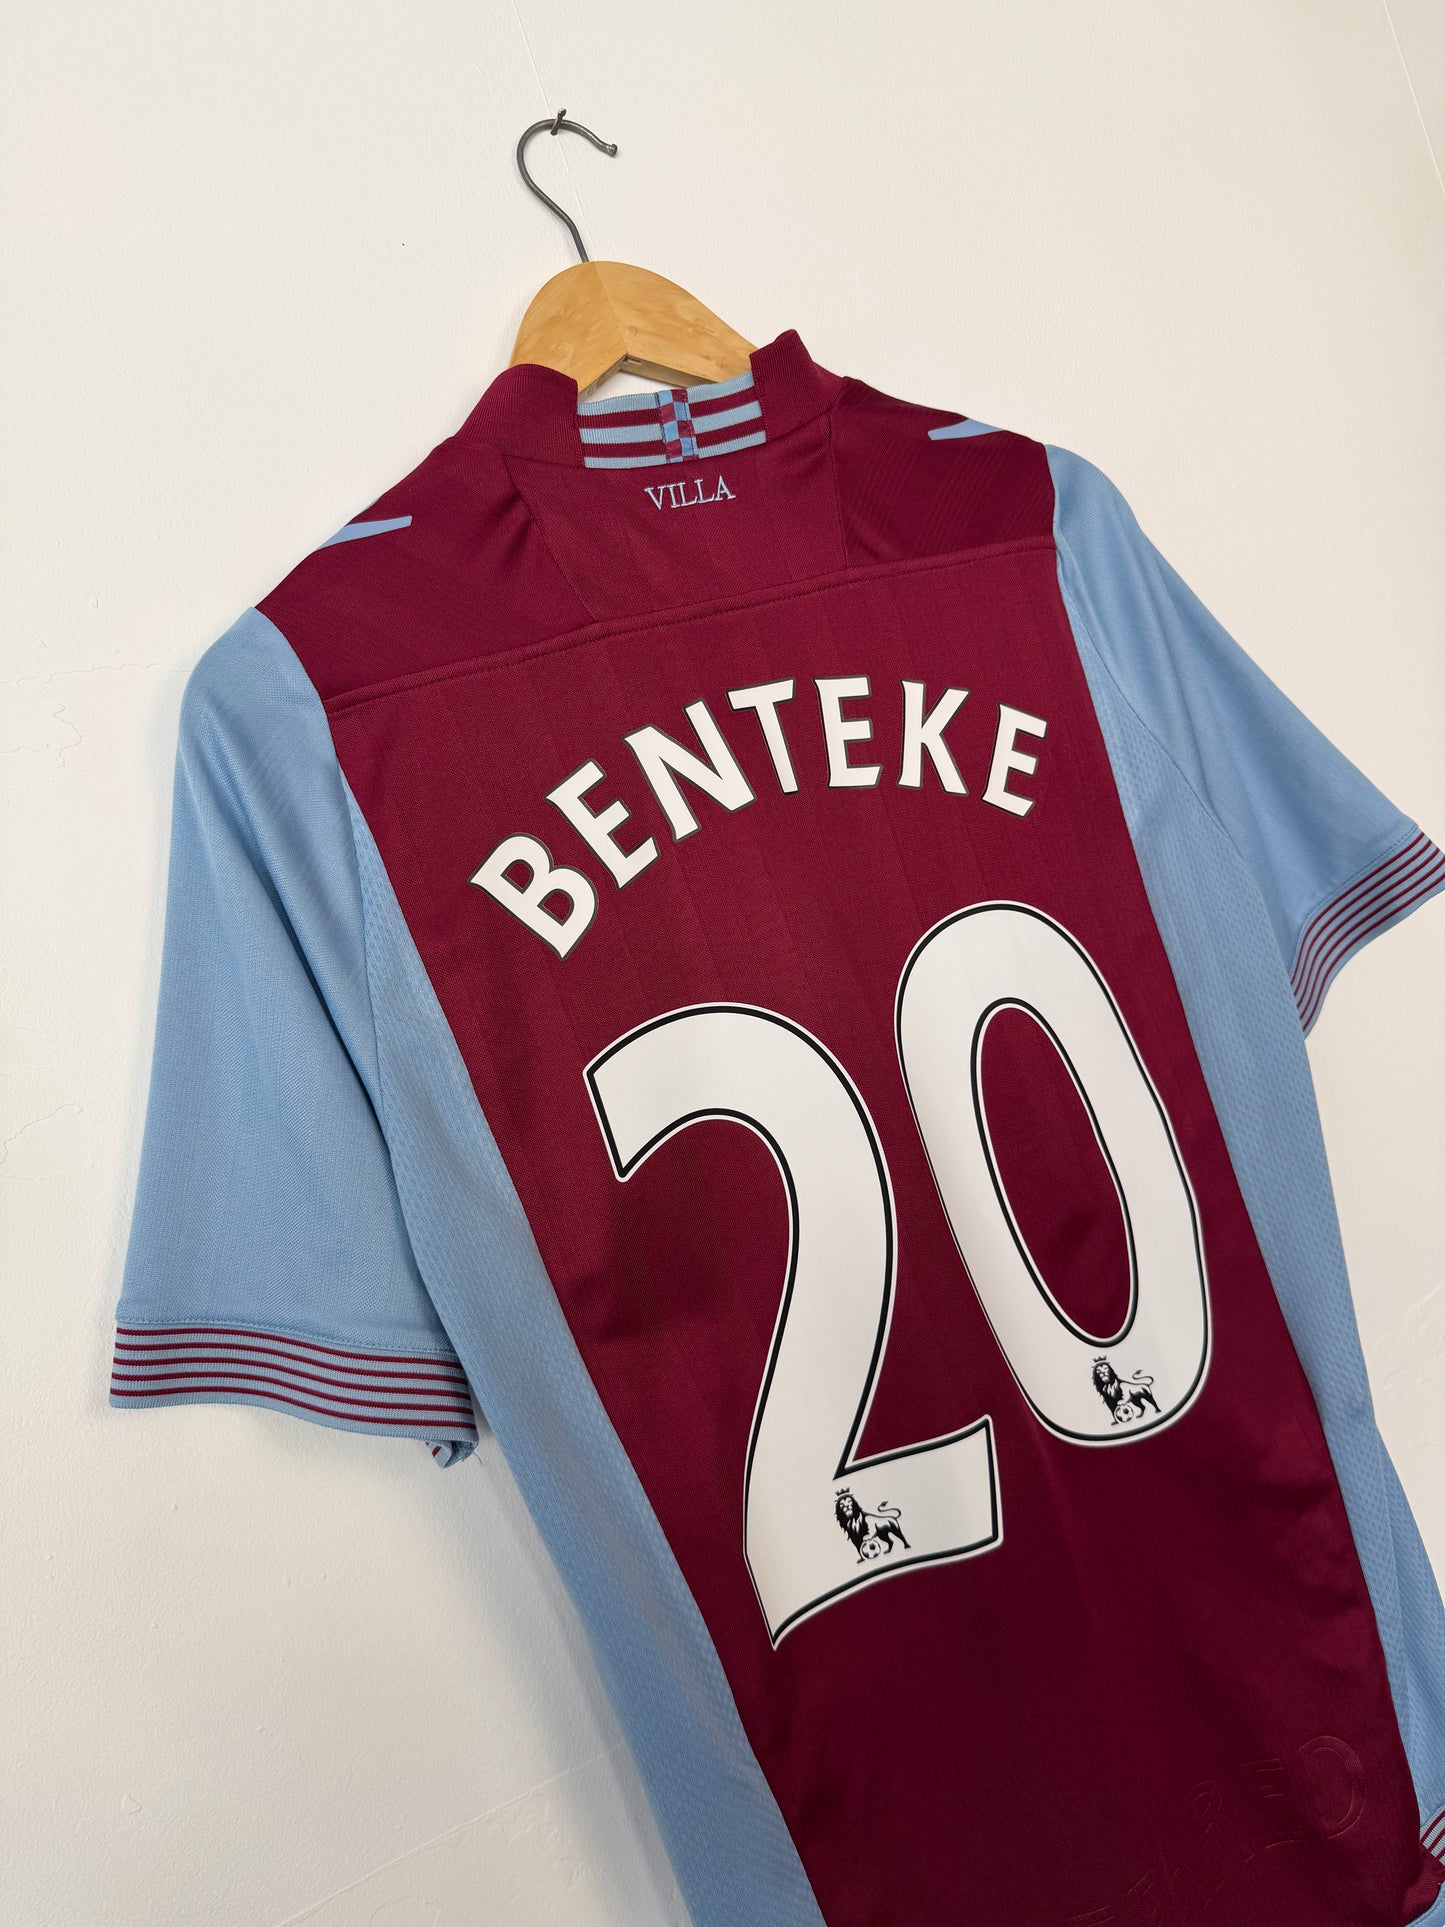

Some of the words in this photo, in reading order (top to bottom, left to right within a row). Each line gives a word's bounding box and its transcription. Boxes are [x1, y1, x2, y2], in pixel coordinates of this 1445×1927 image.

[644, 474, 736, 511] VILLA
[469, 675, 1049, 960] BENTEKE
[583, 900, 1213, 1651] 20
